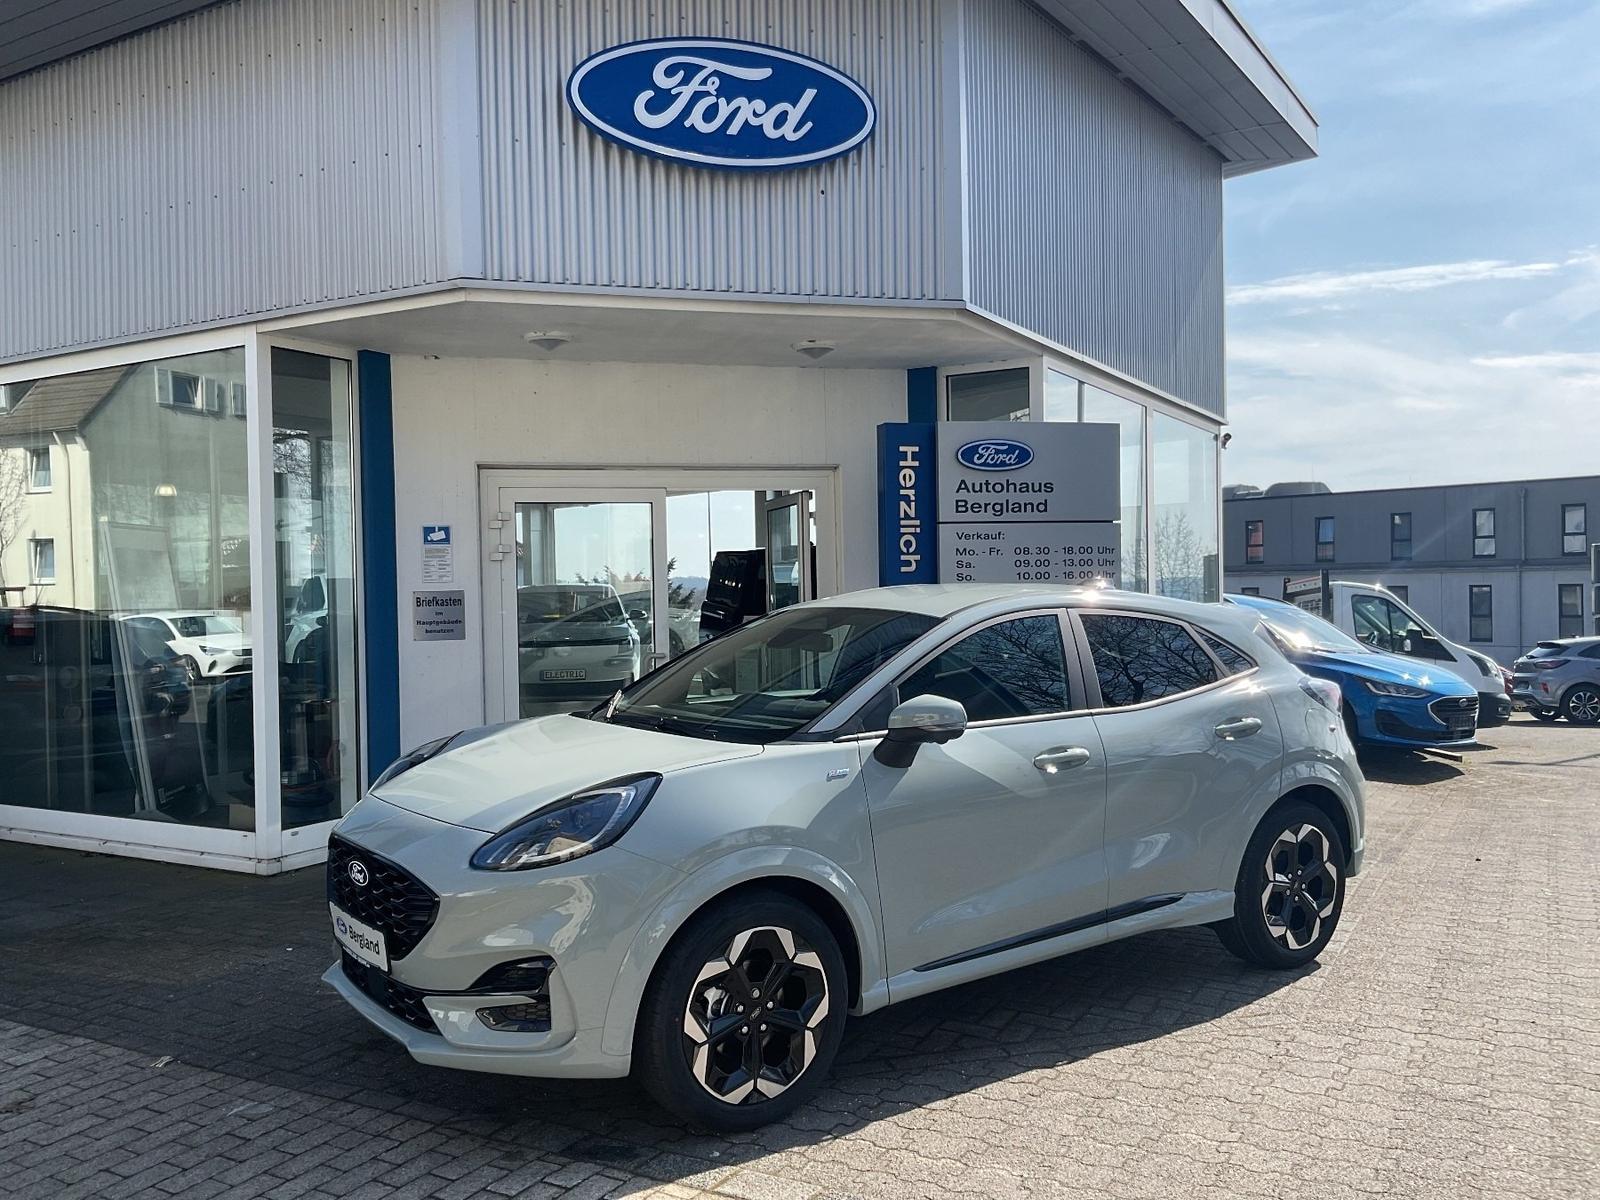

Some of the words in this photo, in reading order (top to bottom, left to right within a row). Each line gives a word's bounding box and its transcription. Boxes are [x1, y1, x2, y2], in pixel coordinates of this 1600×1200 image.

[633, 55, 817, 142] Ford
[973, 444, 1021, 465] Ford
[955, 479, 1055, 494] Autohaus
[898, 445, 921, 573] Herzlich
[955, 499, 1048, 516] Bergland
[956, 531, 1006, 541] Verkauf:
[955, 547, 979, 557] Mo.
[988, 547, 1004, 557] Fr.
[1014, 546, 1051, 556] 08.30
[1062, 546, 1094, 555] 18.00
[1097, 546, 1116, 555] Uhr
[956, 560, 976, 569] Sa.
[1014, 559, 1051, 568] 09.00
[1062, 558, 1094, 568] 13.00
[1097, 558, 1116, 567] Uhr
[956, 573, 976, 582] So.
[1016, 572, 1051, 581] 10.00
[1063, 571, 1094, 580] 16.00
[416, 597, 462, 607] Briefkasten
[544, 670, 584, 679] ELECTRIC
[348, 924, 380, 955] Bergland
